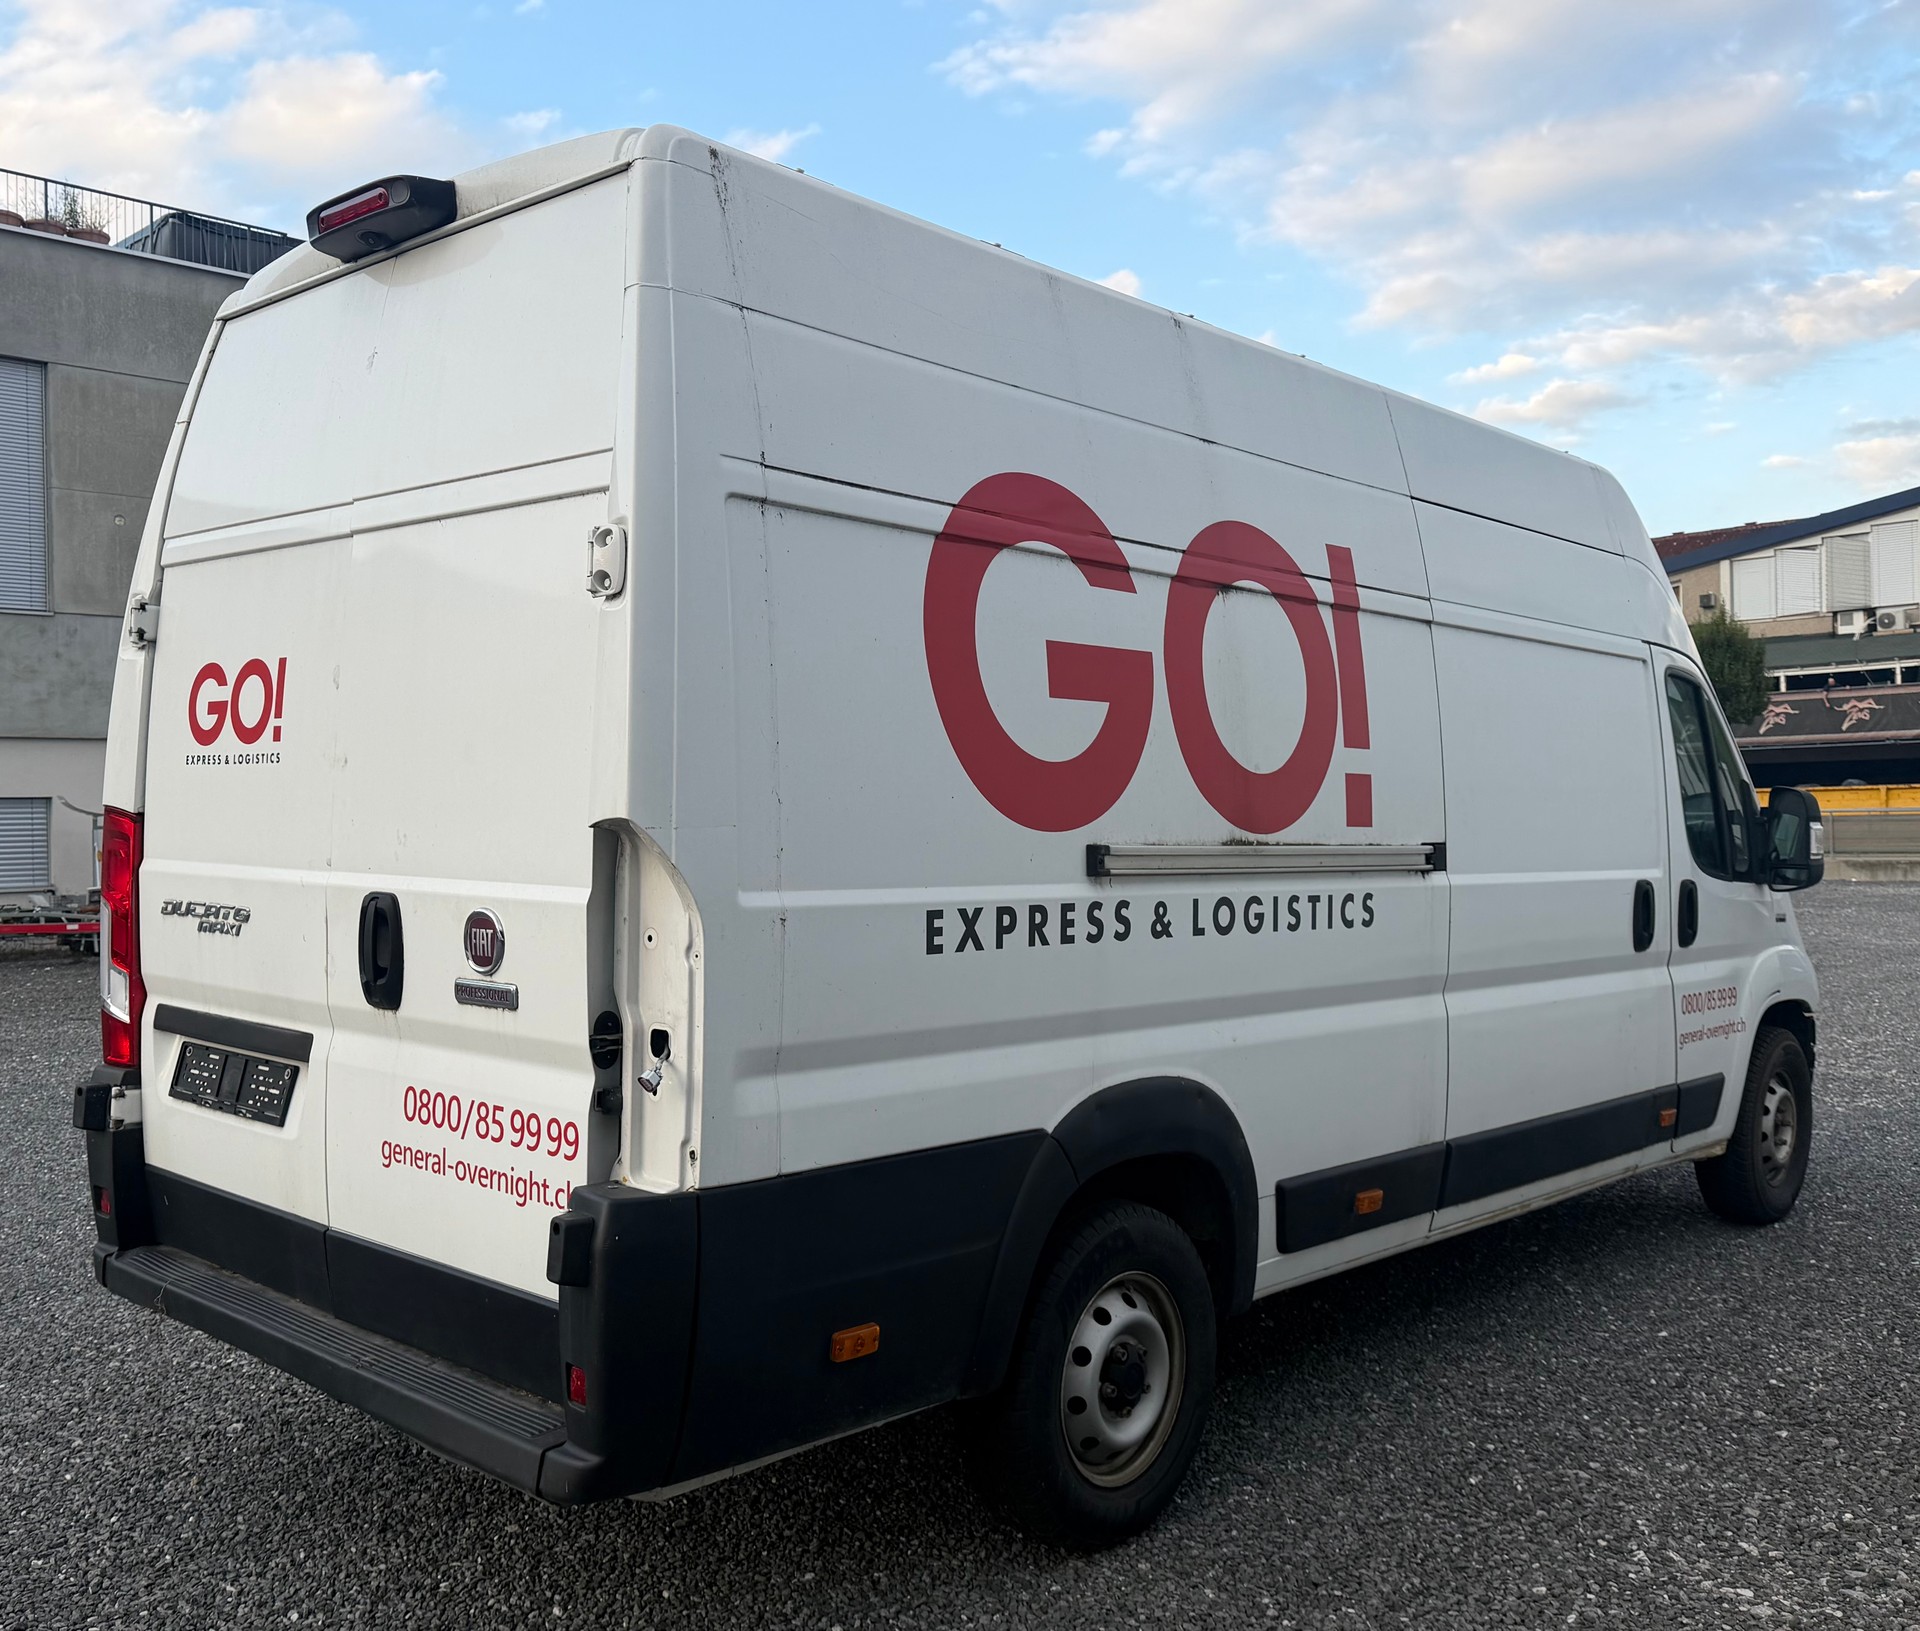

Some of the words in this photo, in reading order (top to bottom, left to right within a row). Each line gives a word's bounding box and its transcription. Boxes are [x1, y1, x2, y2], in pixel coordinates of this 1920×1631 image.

[923, 471, 1373, 835] GO!
[188, 656, 288, 747] GO!
[185, 754, 222, 766] EXPRESS
[224, 755, 230, 765] &
[233, 752, 281, 765] LOGISTICS
[196, 919, 242, 937] MAXI
[925, 900, 1132, 956] EXPRESS
[1150, 899, 1174, 939] &
[1192, 892, 1376, 937] LOGISTICS
[471, 927, 494, 958] FIAT
[456, 984, 510, 1003] PROFESSIONAL
[1679, 1016, 1747, 1050] general-overnight.ch
[403, 1085, 505, 1144] 0800/85
[510, 1109, 542, 1152] 99
[546, 1117, 580, 1162] 99
